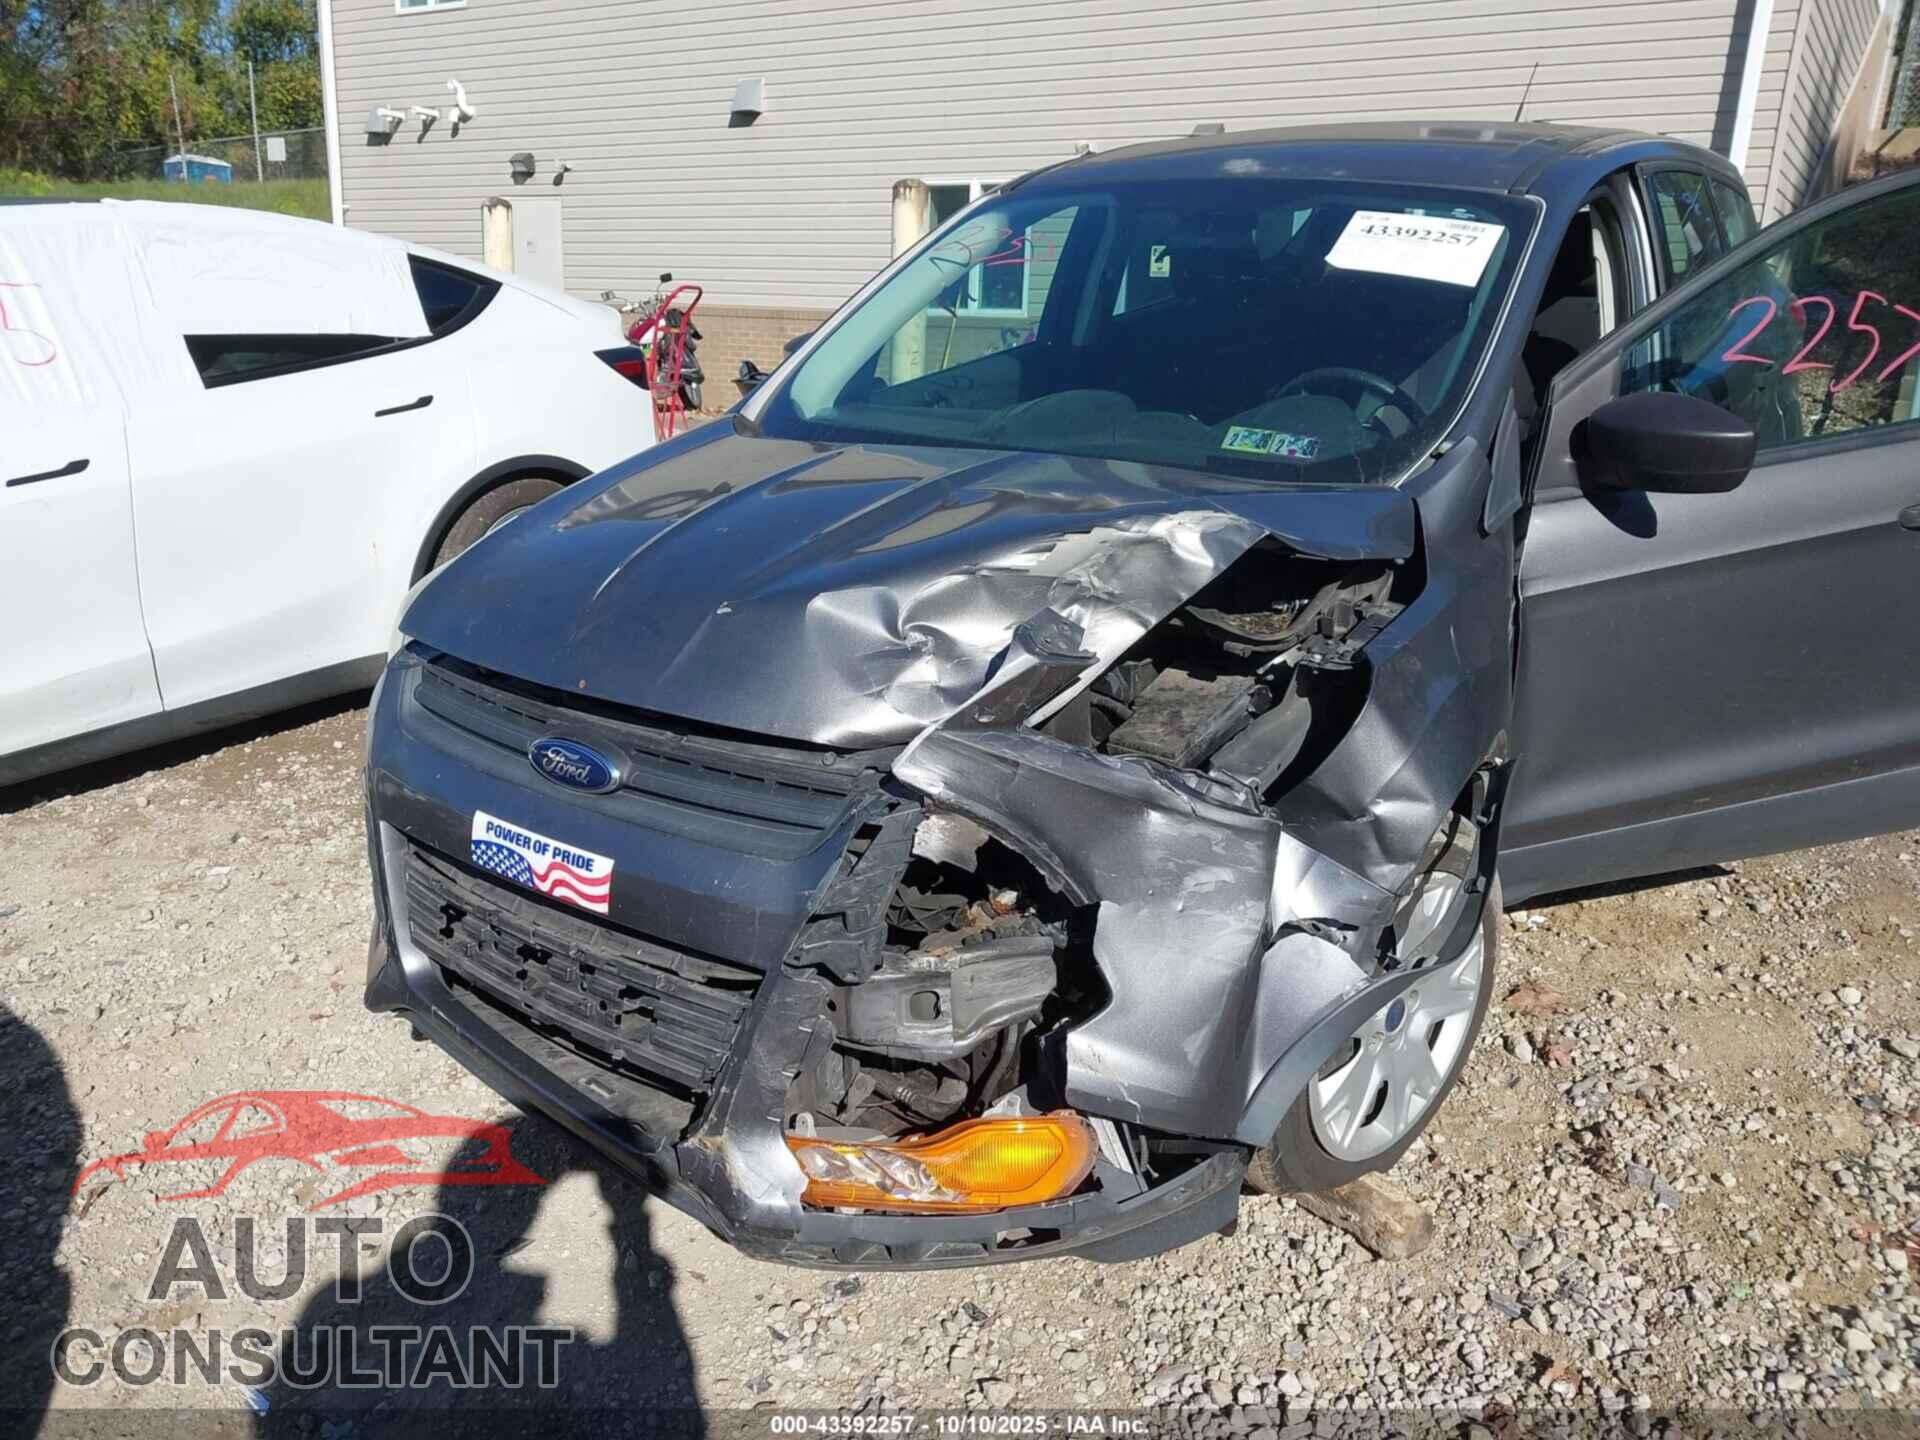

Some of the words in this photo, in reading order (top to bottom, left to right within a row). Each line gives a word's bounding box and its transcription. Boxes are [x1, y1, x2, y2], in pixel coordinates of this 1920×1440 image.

[1360, 224, 1478, 247] 43392257
[542, 747, 592, 785] Ford
[486, 821, 532, 850] POWER
[533, 839, 551, 857] OF
[552, 846, 595, 873] PRIDE
